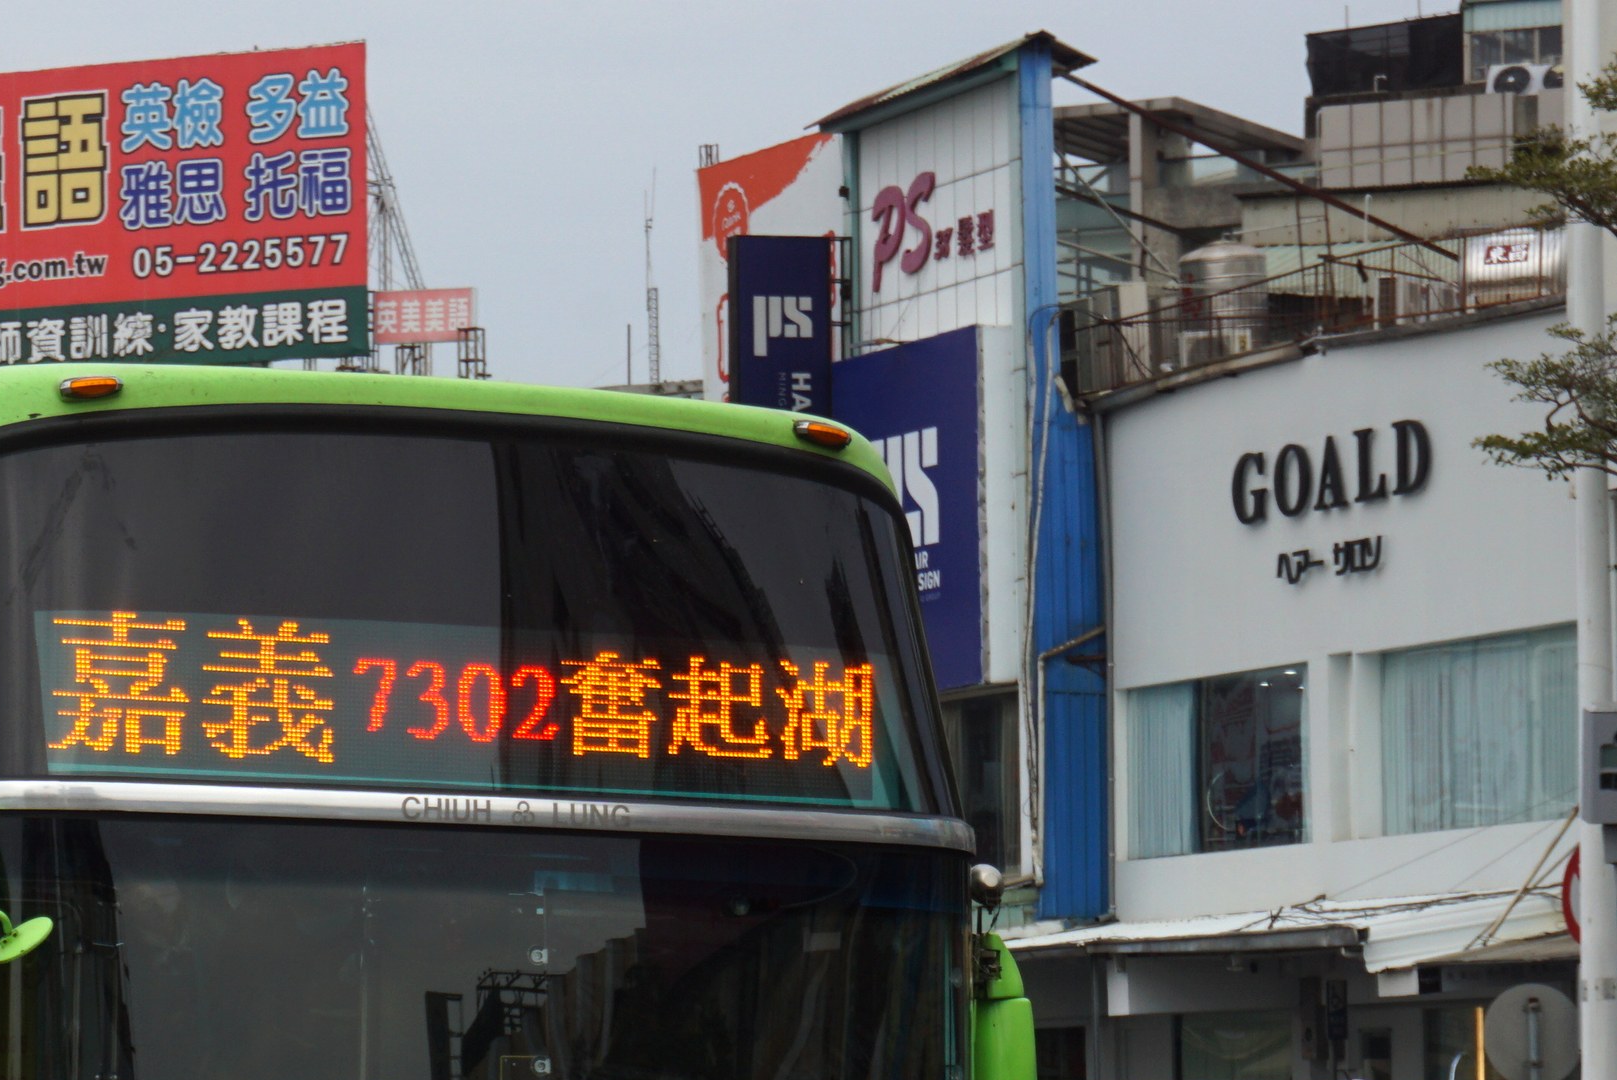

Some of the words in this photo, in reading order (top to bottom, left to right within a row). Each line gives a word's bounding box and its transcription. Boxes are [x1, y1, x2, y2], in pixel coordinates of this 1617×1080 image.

[120, 78, 223, 154] 英檢
[246, 67, 349, 144] 多益
[120, 158, 226, 230] 雅思
[244, 147, 351, 222] 托福
[132, 232, 349, 278] 05-2225577
[377, 298, 469, 334] 英美美語
[1232, 419, 1433, 526] GOALD
[48, 611, 335, 764] 嘉義
[351, 656, 560, 744] 7302
[559, 650, 876, 769] 奮起湖
[401, 796, 492, 824] CHIUH
[551, 802, 631, 828] LUNG
